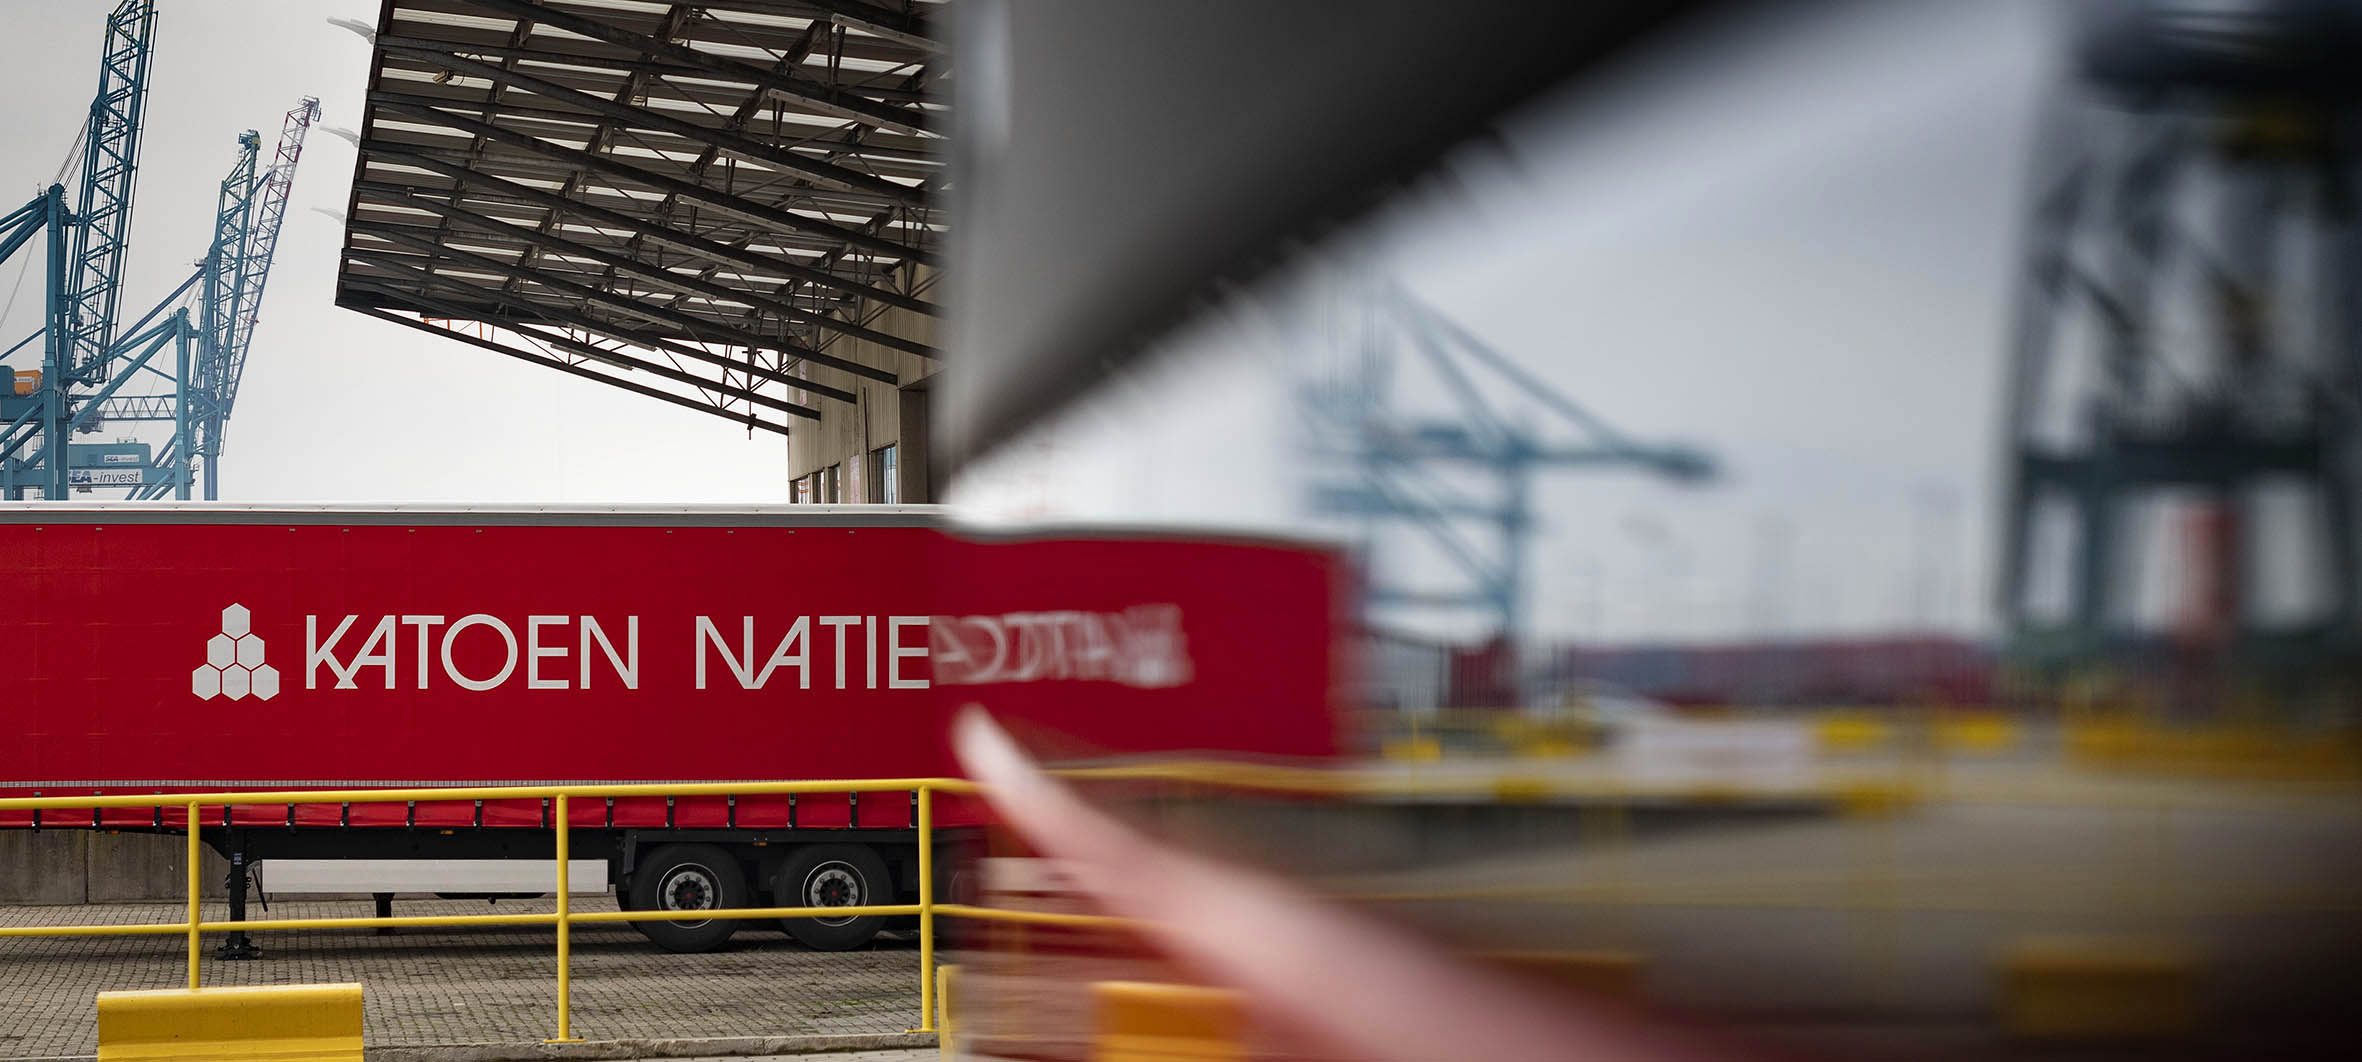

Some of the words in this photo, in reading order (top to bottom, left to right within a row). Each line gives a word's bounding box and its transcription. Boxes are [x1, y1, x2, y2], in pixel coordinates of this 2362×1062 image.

[68, 470, 140, 483] EA-invest
[305, 613, 639, 690] KATOEN
[696, 615, 930, 689] NATIE
